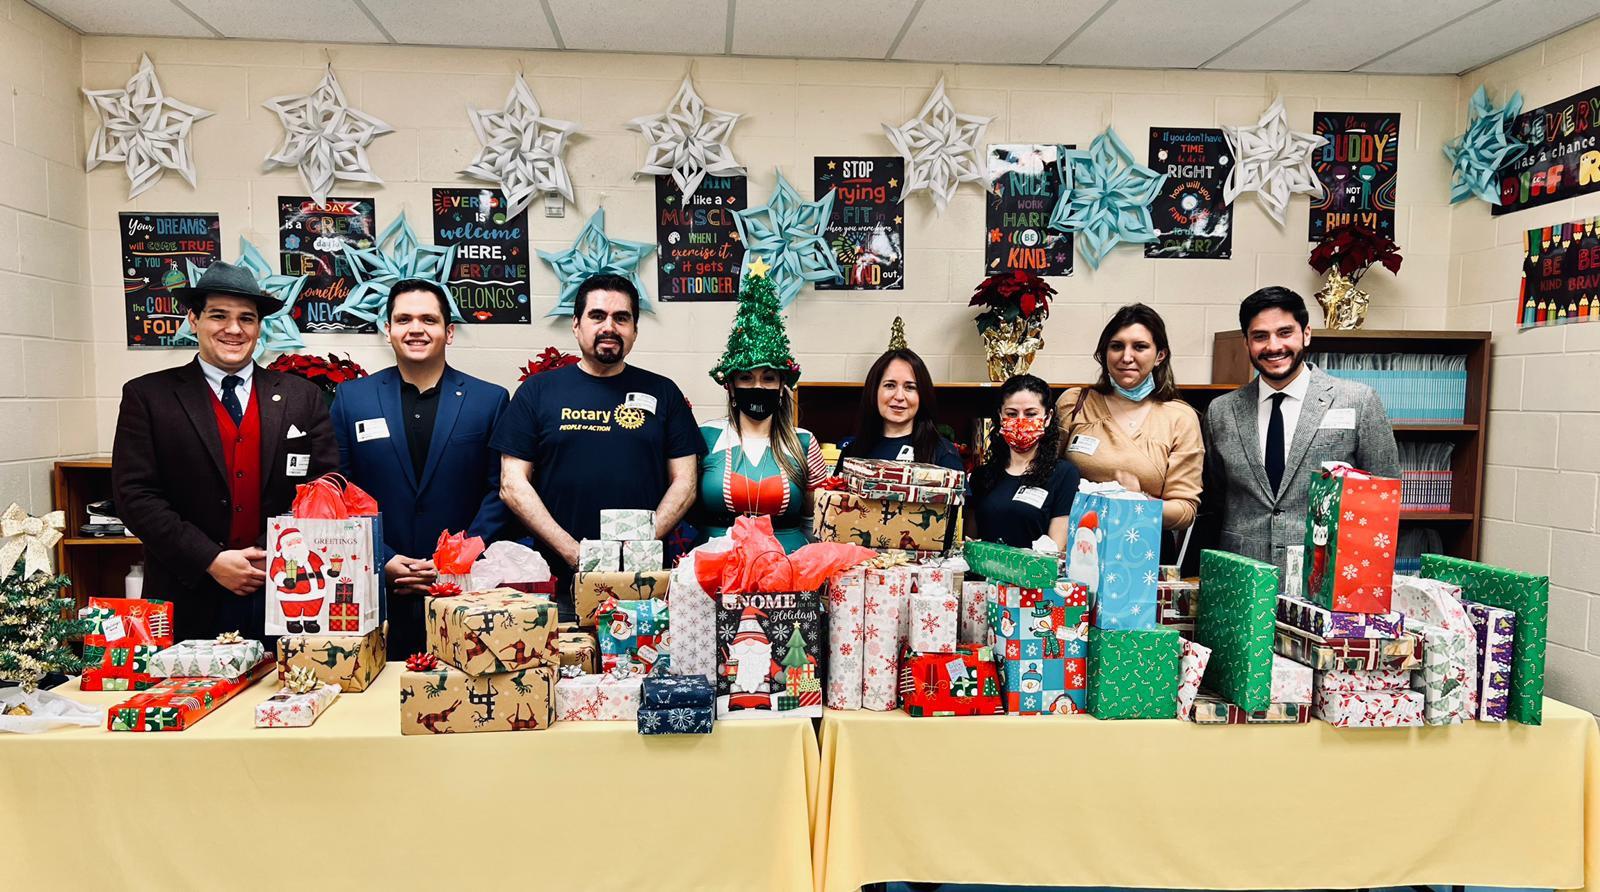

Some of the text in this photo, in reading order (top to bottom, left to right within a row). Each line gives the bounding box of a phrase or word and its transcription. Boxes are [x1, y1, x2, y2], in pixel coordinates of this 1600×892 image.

[1170, 135, 1184, 144] you
[1205, 133, 1222, 142] have
[1181, 144, 1204, 153] TIME
[1323, 134, 1389, 162] BUDDY
[1540, 152, 1547, 162] a
[1552, 136, 1596, 158] chance
[843, 161, 874, 178] STOP
[1168, 165, 1214, 178] RIGHT
[703, 176, 731, 190] AIN
[1170, 181, 1212, 201] how will you
[694, 196, 712, 204] like
[714, 196, 722, 204] a
[1018, 200, 1044, 209] WORK
[476, 212, 486, 222] IS
[661, 208, 732, 226] MUSCL
[844, 207, 872, 223] FIT
[1168, 206, 1188, 224] FIND
[128, 218, 208, 236] Your DREAMS
[285, 220, 293, 229] is
[440, 222, 520, 240] welcome
[688, 232, 712, 244] WHEN
[129, 242, 144, 251] will
[179, 241, 214, 251] TRUE
[457, 246, 506, 260] HERE,
[672, 248, 716, 259] exercise
[1007, 248, 1050, 270] KIND.
[1578, 246, 1600, 270] BE
[135, 257, 142, 268] IF
[144, 257, 160, 268] YOU
[285, 254, 352, 276] LEAR
[682, 262, 724, 275] it gets
[1543, 256, 1562, 277] BE
[882, 270, 900, 278] out.
[672, 278, 736, 294] STRONGER.
[1540, 278, 1562, 292] KIND
[1568, 274, 1600, 292] BRAV
[133, 304, 145, 312] the
[562, 408, 611, 423] Rotary
[722, 594, 797, 610] GNOME
[807, 600, 816, 608] the
[770, 610, 817, 623] Holidays
